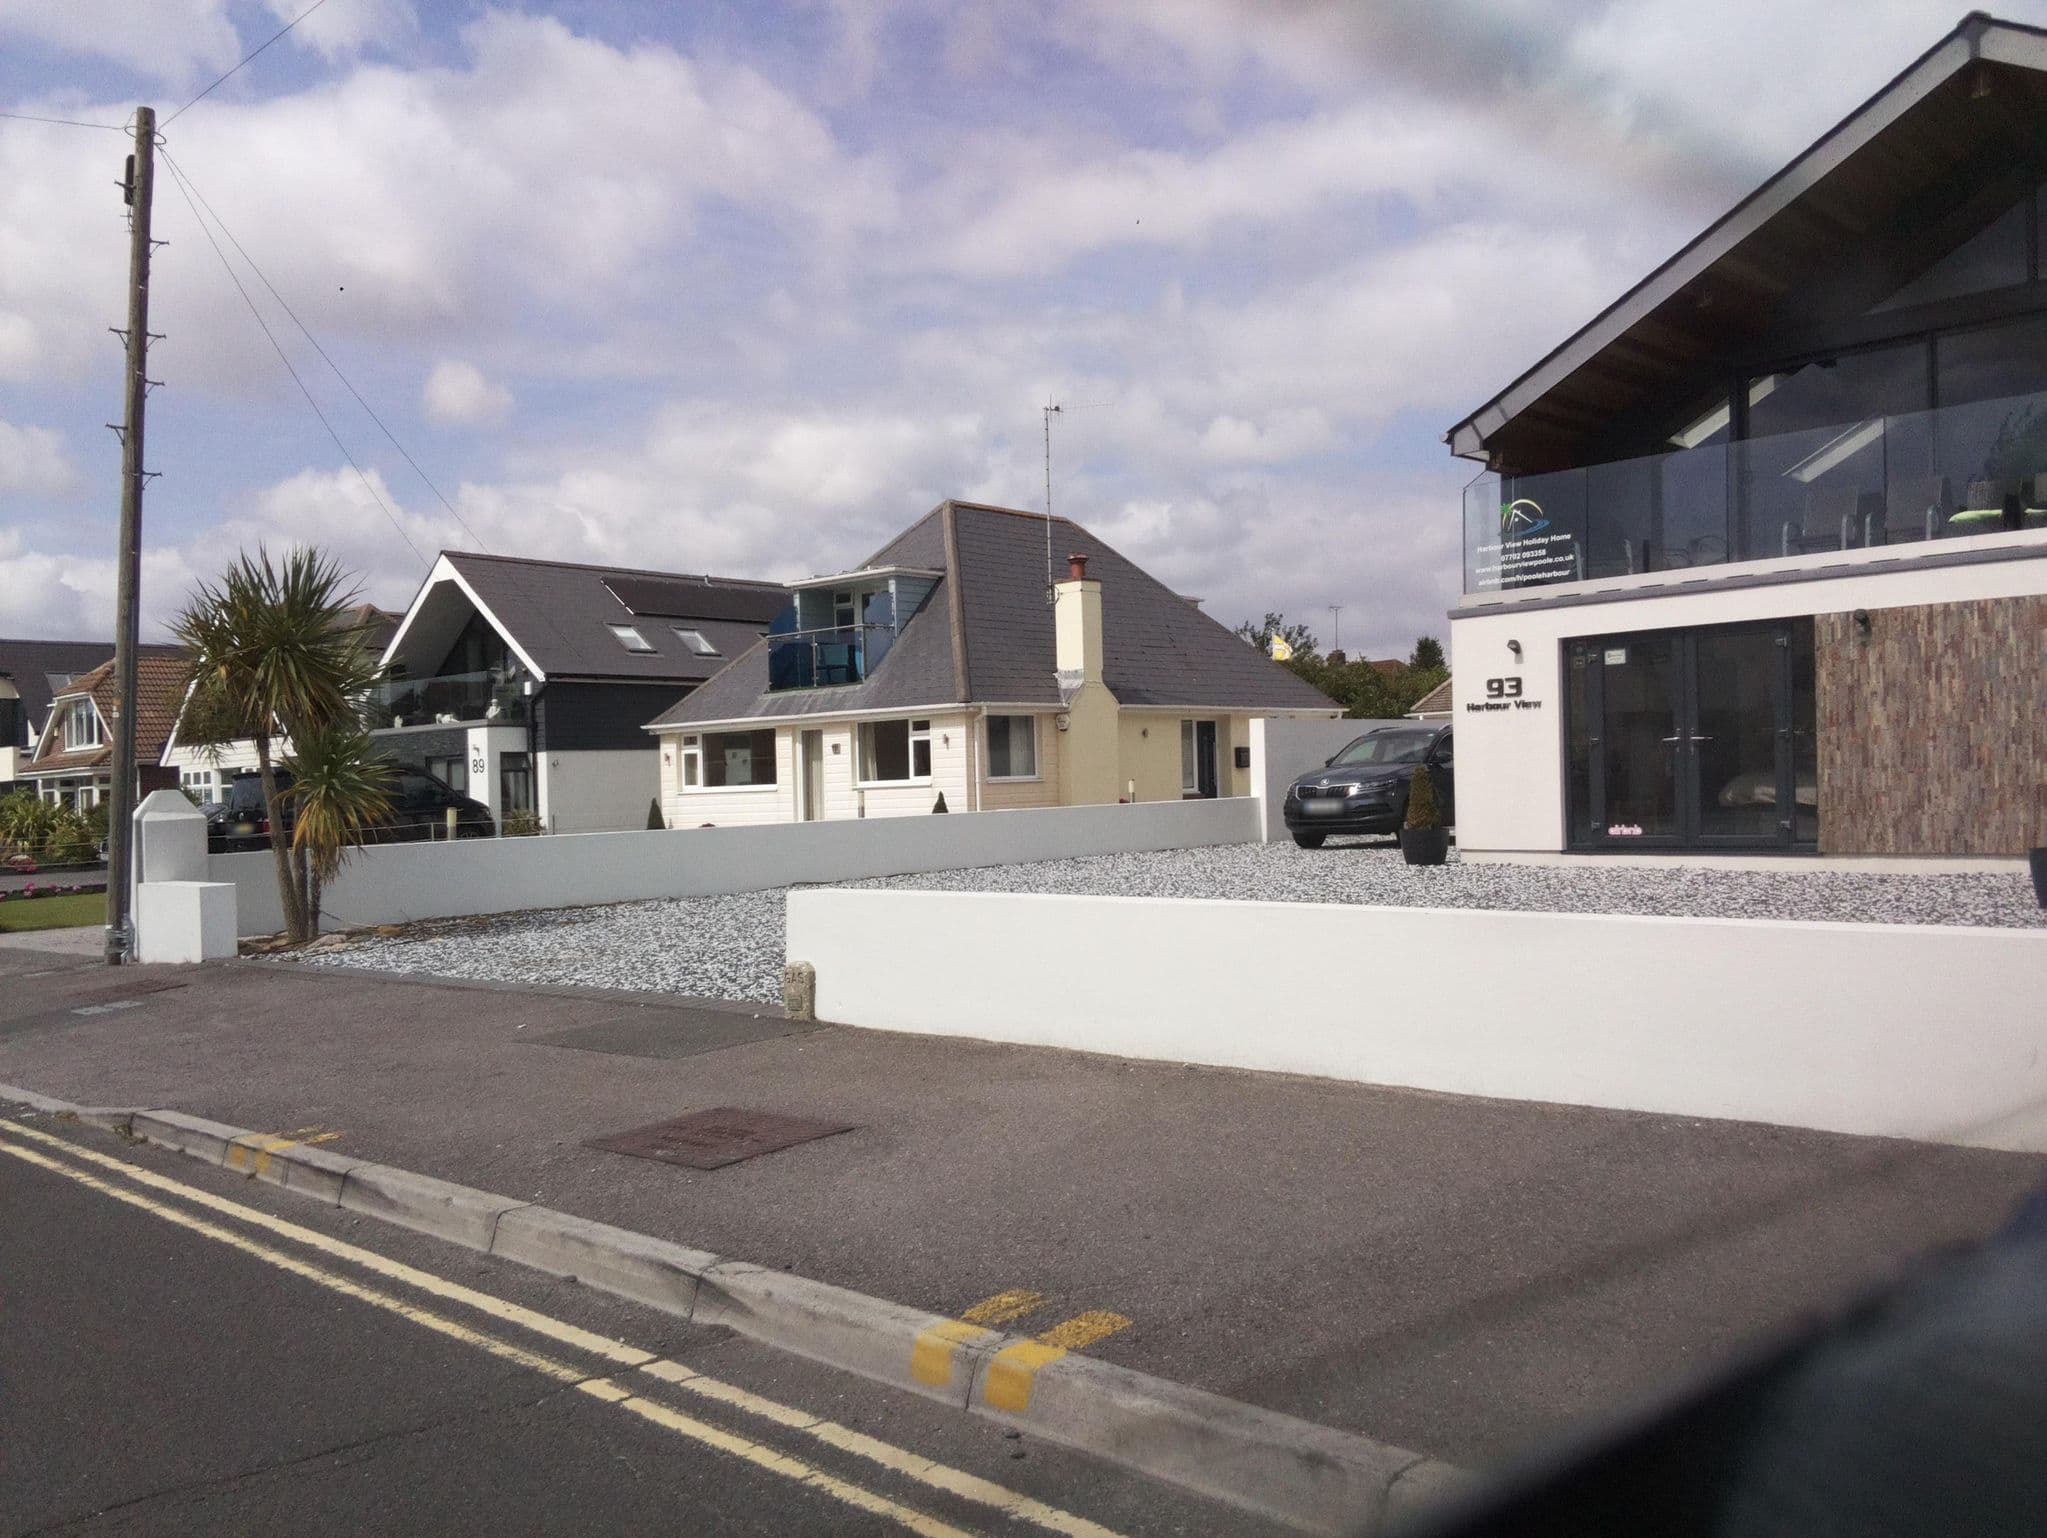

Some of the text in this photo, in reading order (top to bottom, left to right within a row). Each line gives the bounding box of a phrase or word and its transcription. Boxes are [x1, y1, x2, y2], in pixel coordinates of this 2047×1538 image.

[1505, 541, 1522, 549] View
[1523, 537, 1549, 546] Holiday
[1486, 676, 1523, 699] 93
[1466, 699, 1543, 713] Harbour View
[473, 758, 484, 773] 89
